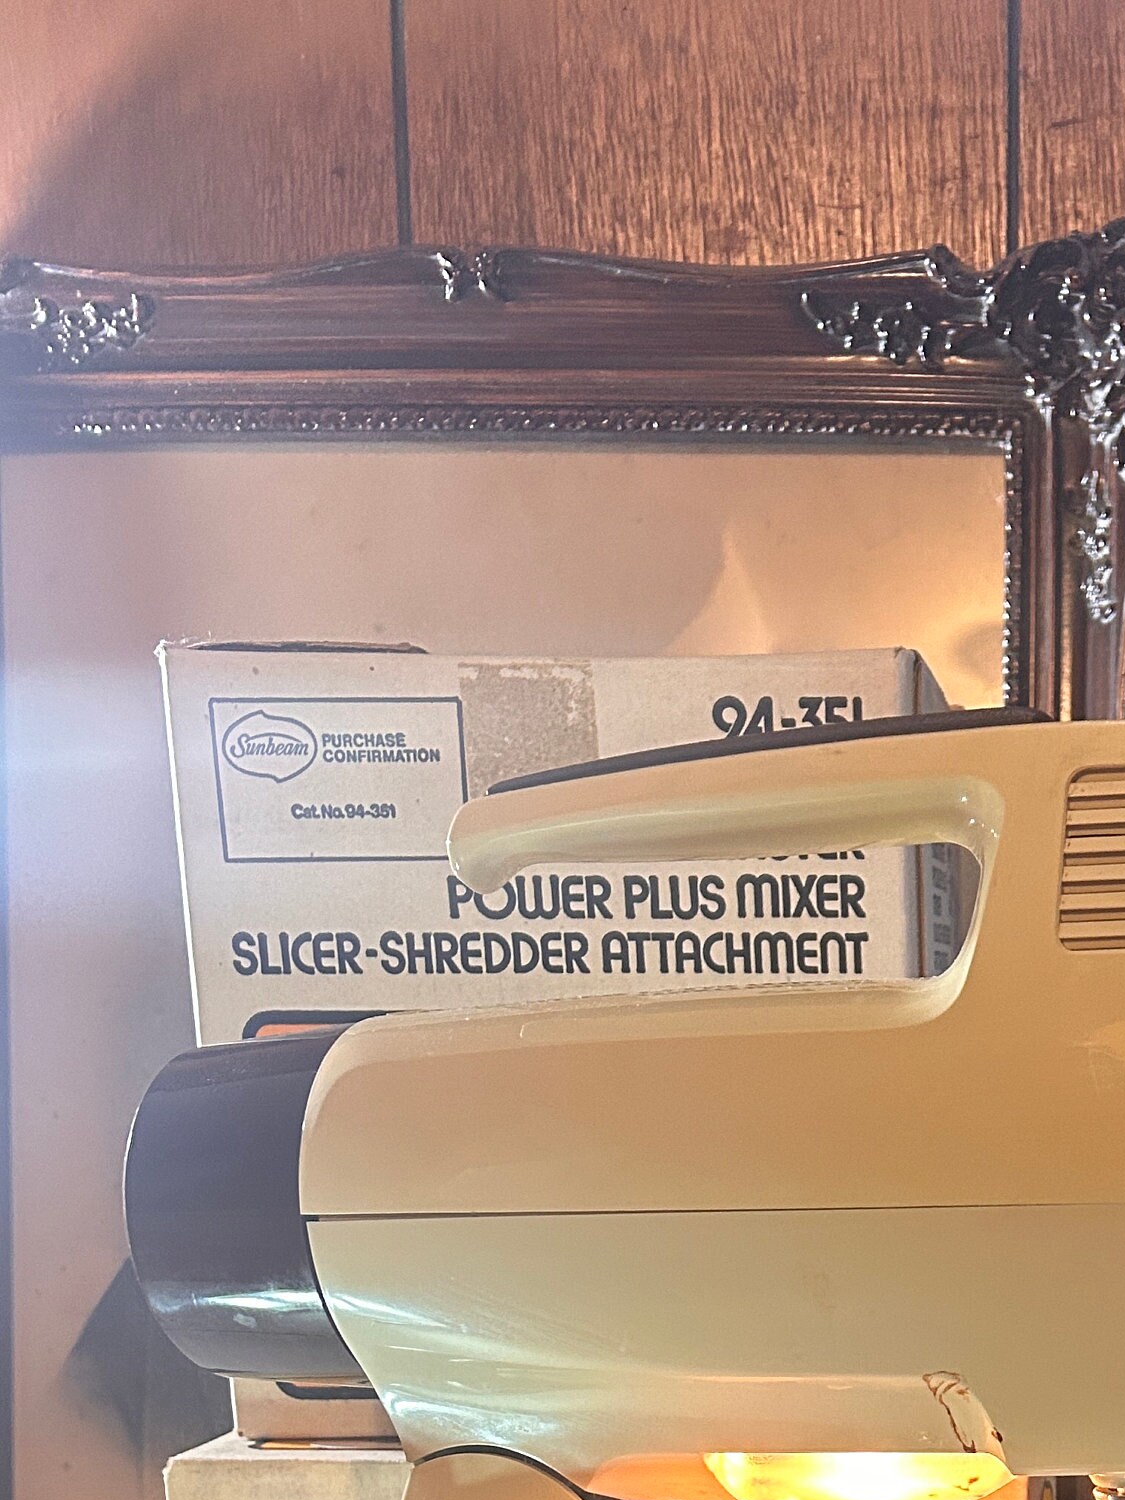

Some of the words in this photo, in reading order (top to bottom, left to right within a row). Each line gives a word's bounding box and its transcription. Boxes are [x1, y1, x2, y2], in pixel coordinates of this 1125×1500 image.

[230, 731, 309, 759] Sunbeam
[321, 732, 407, 748] PURCHASE
[322, 748, 441, 764] CONFIRMATION
[447, 874, 612, 920] POWER
[626, 874, 725, 920] PLUS
[737, 874, 866, 919] MIXER
[232, 930, 590, 975] SLICER-SHREDDER
[601, 931, 869, 975] ATTACHMENT
